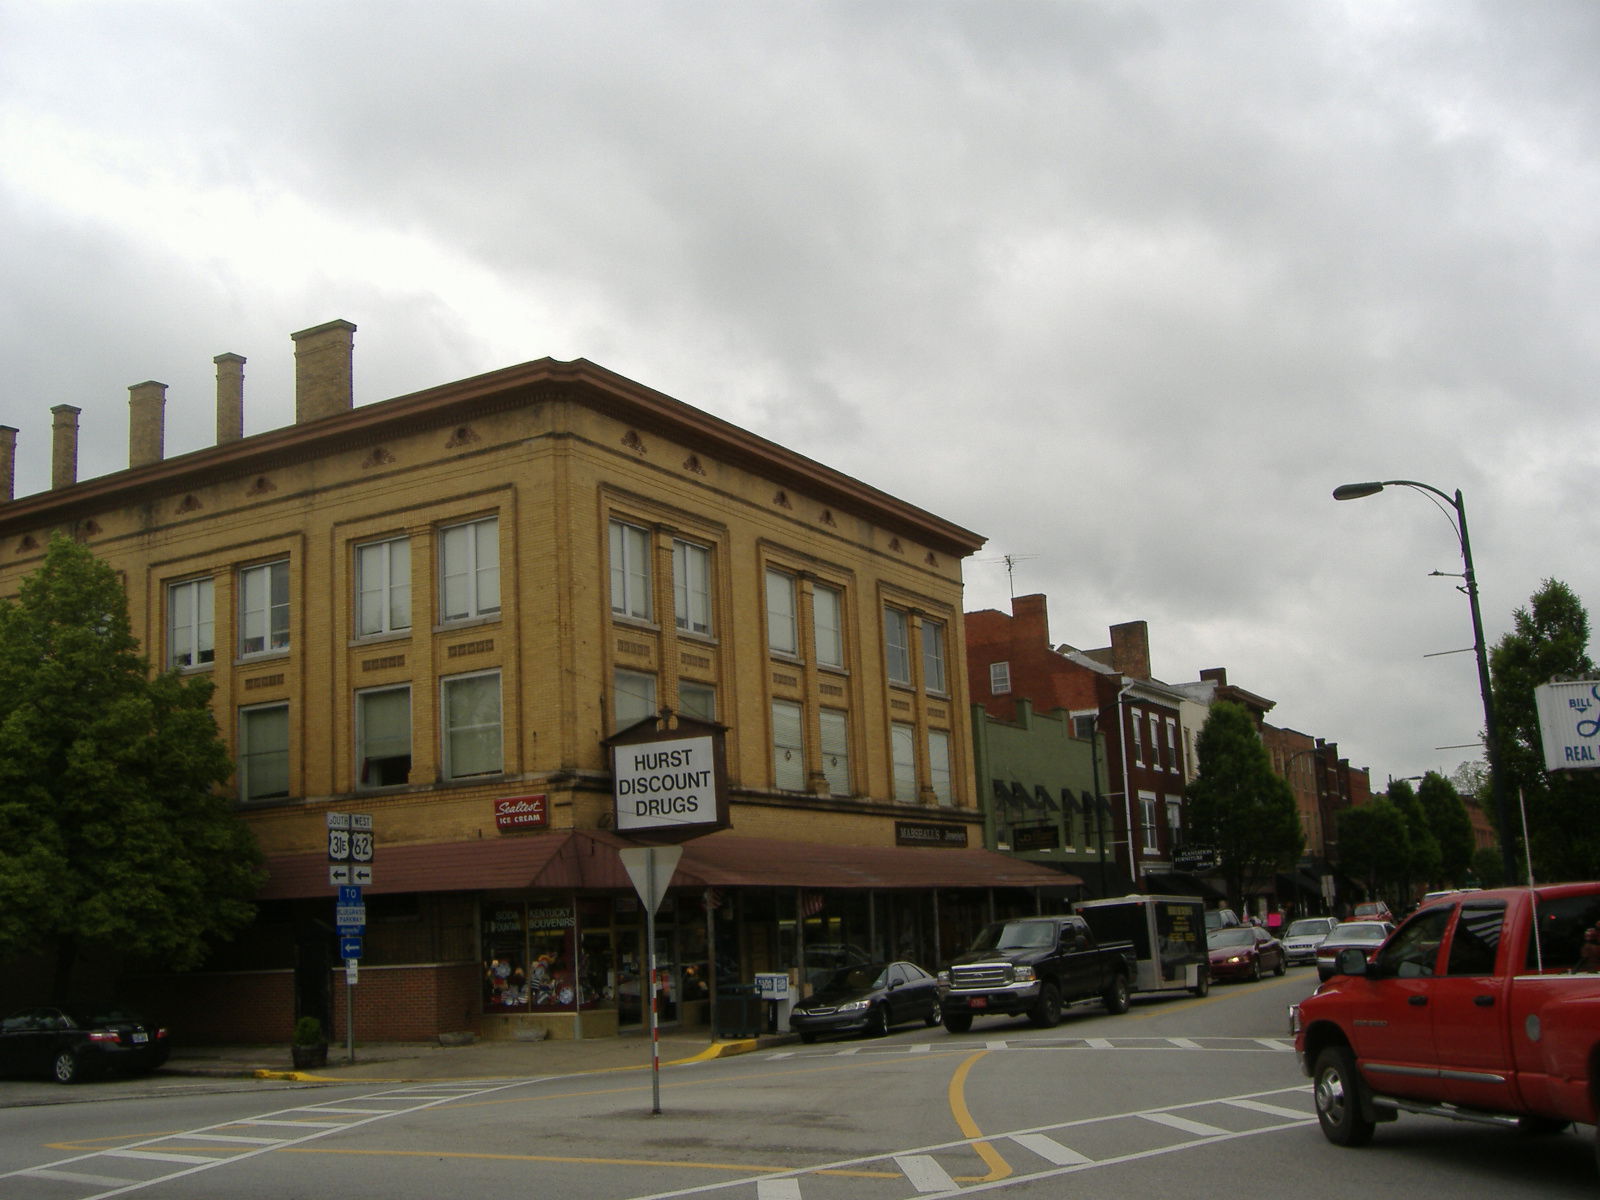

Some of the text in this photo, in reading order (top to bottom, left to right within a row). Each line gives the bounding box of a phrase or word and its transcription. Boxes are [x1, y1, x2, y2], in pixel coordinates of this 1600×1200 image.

[1569, 698, 1592, 708] BILL
[1565, 745, 1596, 762] REAL
[634, 749, 693, 771] HURST
[619, 771, 711, 796] DISCOUNT
[496, 800, 544, 816] Sealtest
[636, 795, 698, 817] DRUGS
[329, 815, 349, 825] SOUTH
[354, 816, 370, 826] WEST
[499, 814, 541, 824] ICE CREAM
[355, 837, 369, 855] 62
[345, 888, 357, 899] TO
[529, 907, 571, 918] KENTUCKY
[529, 917, 576, 929] SOUVENIRS
